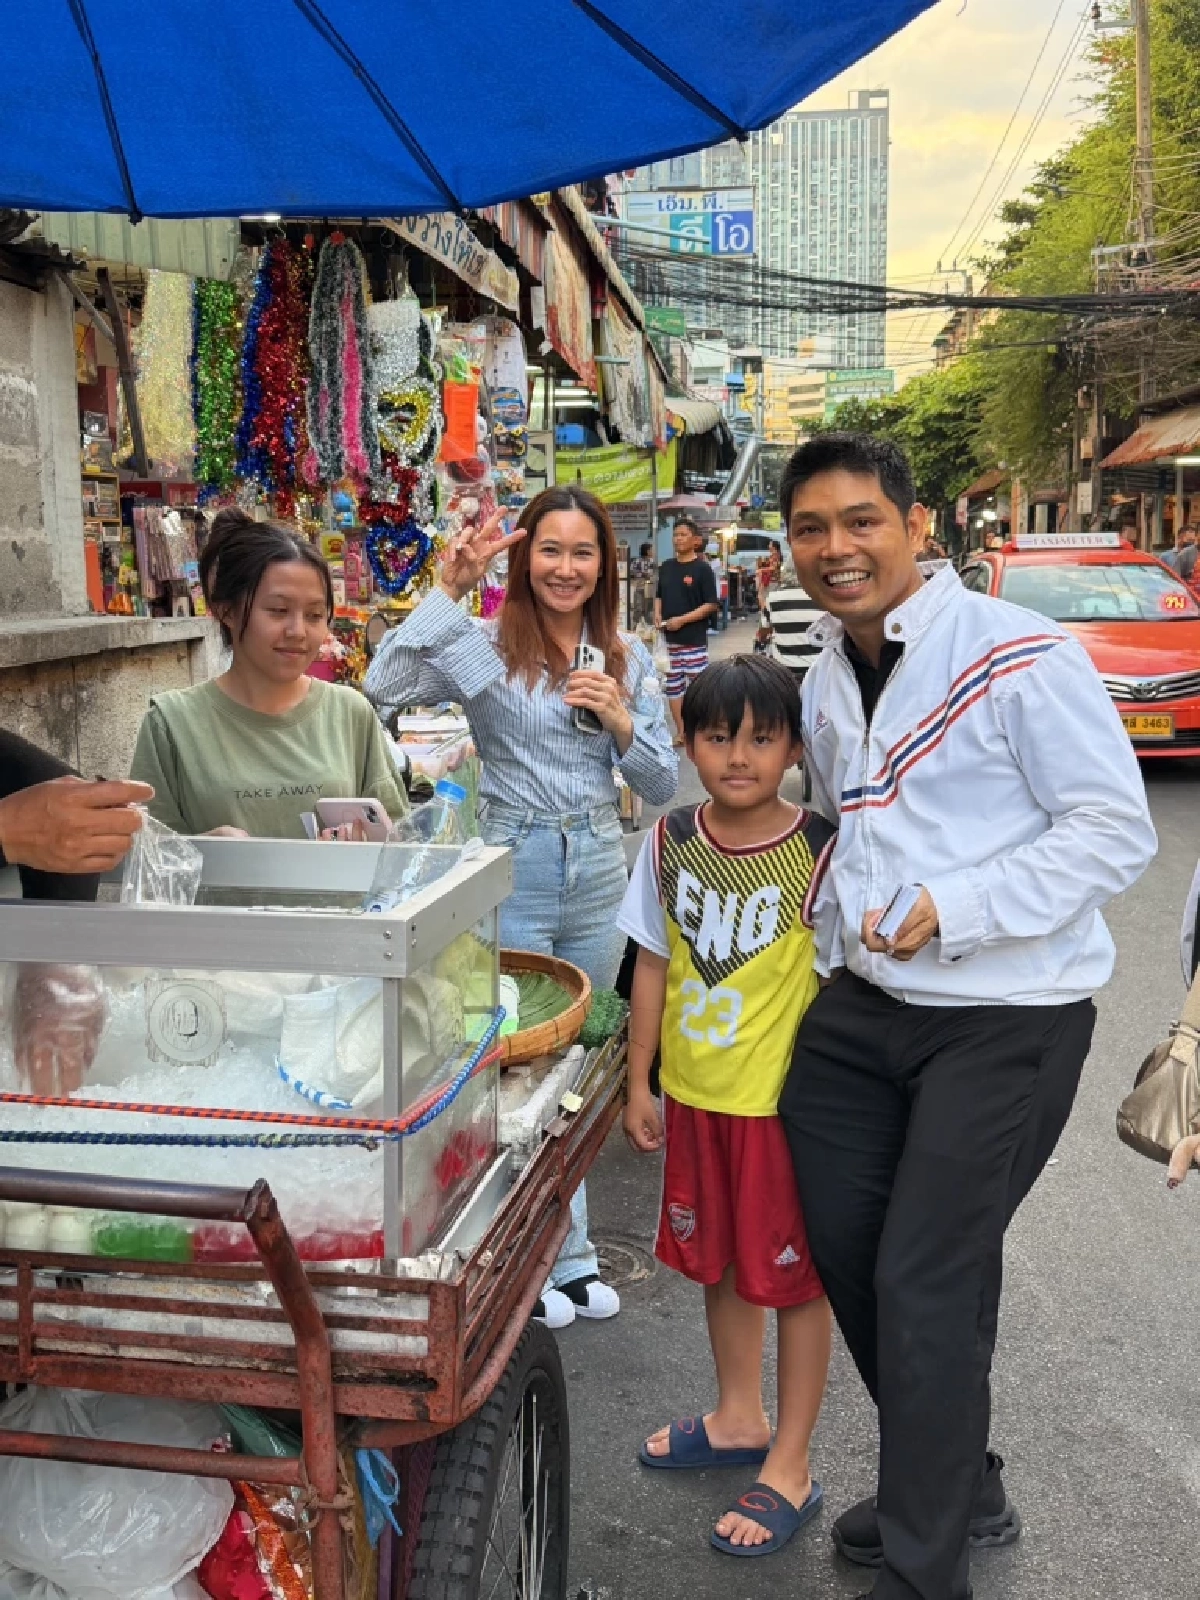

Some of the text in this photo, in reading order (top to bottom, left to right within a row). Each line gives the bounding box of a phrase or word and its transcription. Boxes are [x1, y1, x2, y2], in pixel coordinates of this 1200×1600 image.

[233, 783, 324, 799] TAKE AWAY
[676, 866, 781, 962] ENG
[680, 977, 743, 1048] 23
